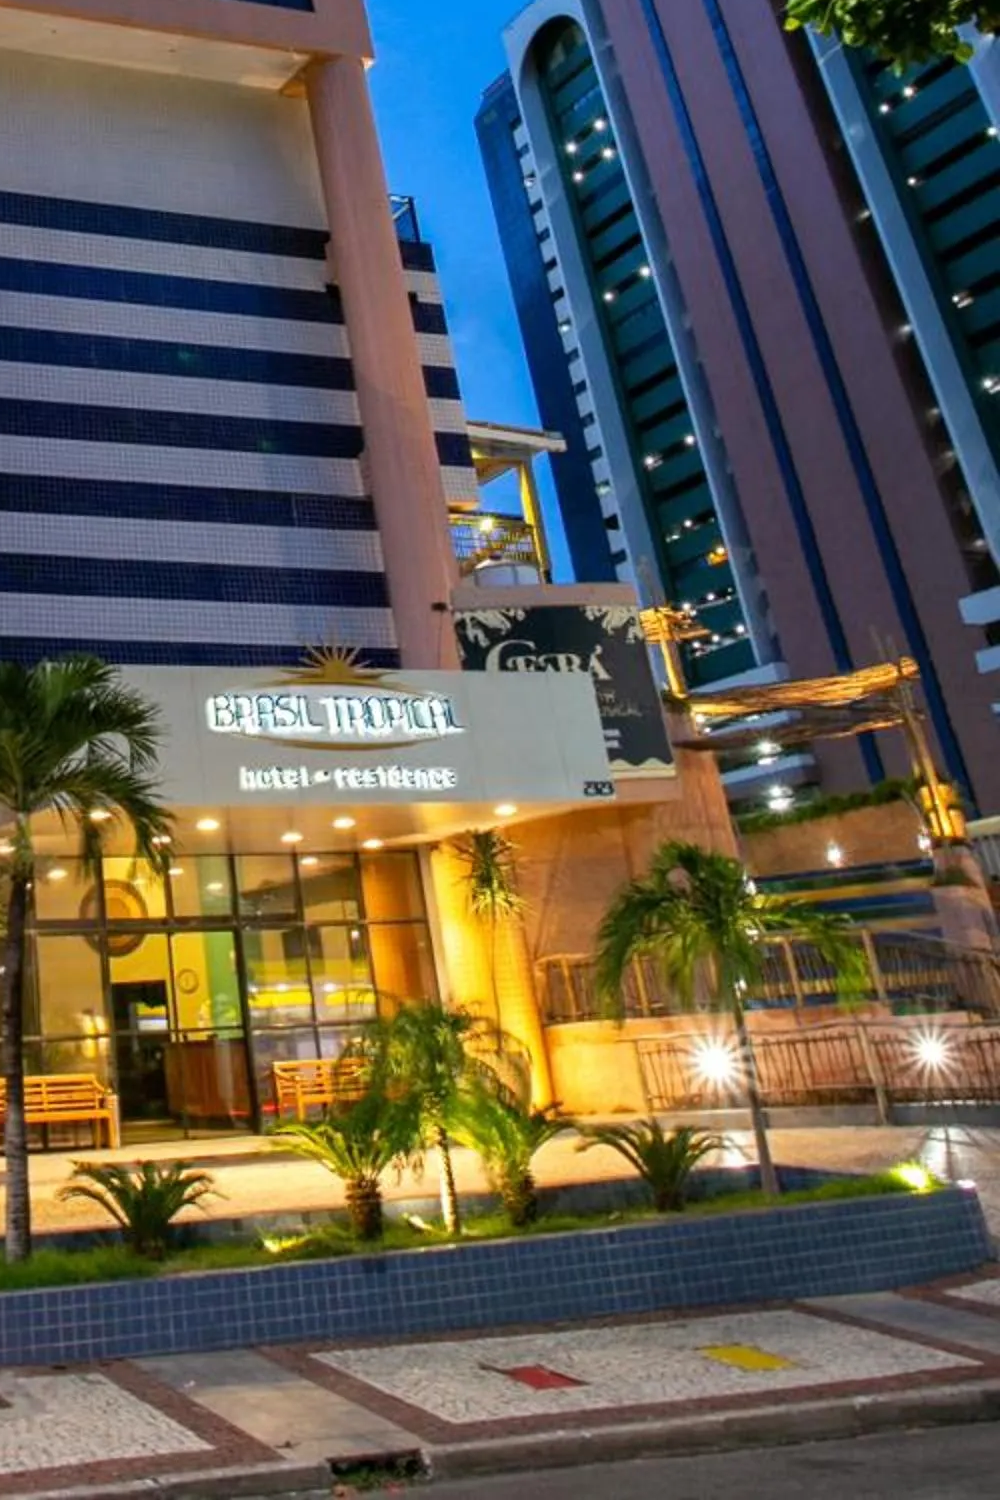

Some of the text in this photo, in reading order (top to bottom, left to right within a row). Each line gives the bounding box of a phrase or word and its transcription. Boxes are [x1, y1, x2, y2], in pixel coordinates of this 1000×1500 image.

[206, 693, 465, 736] BRASIL TROPICAL
[239, 766, 309, 790] hotel
